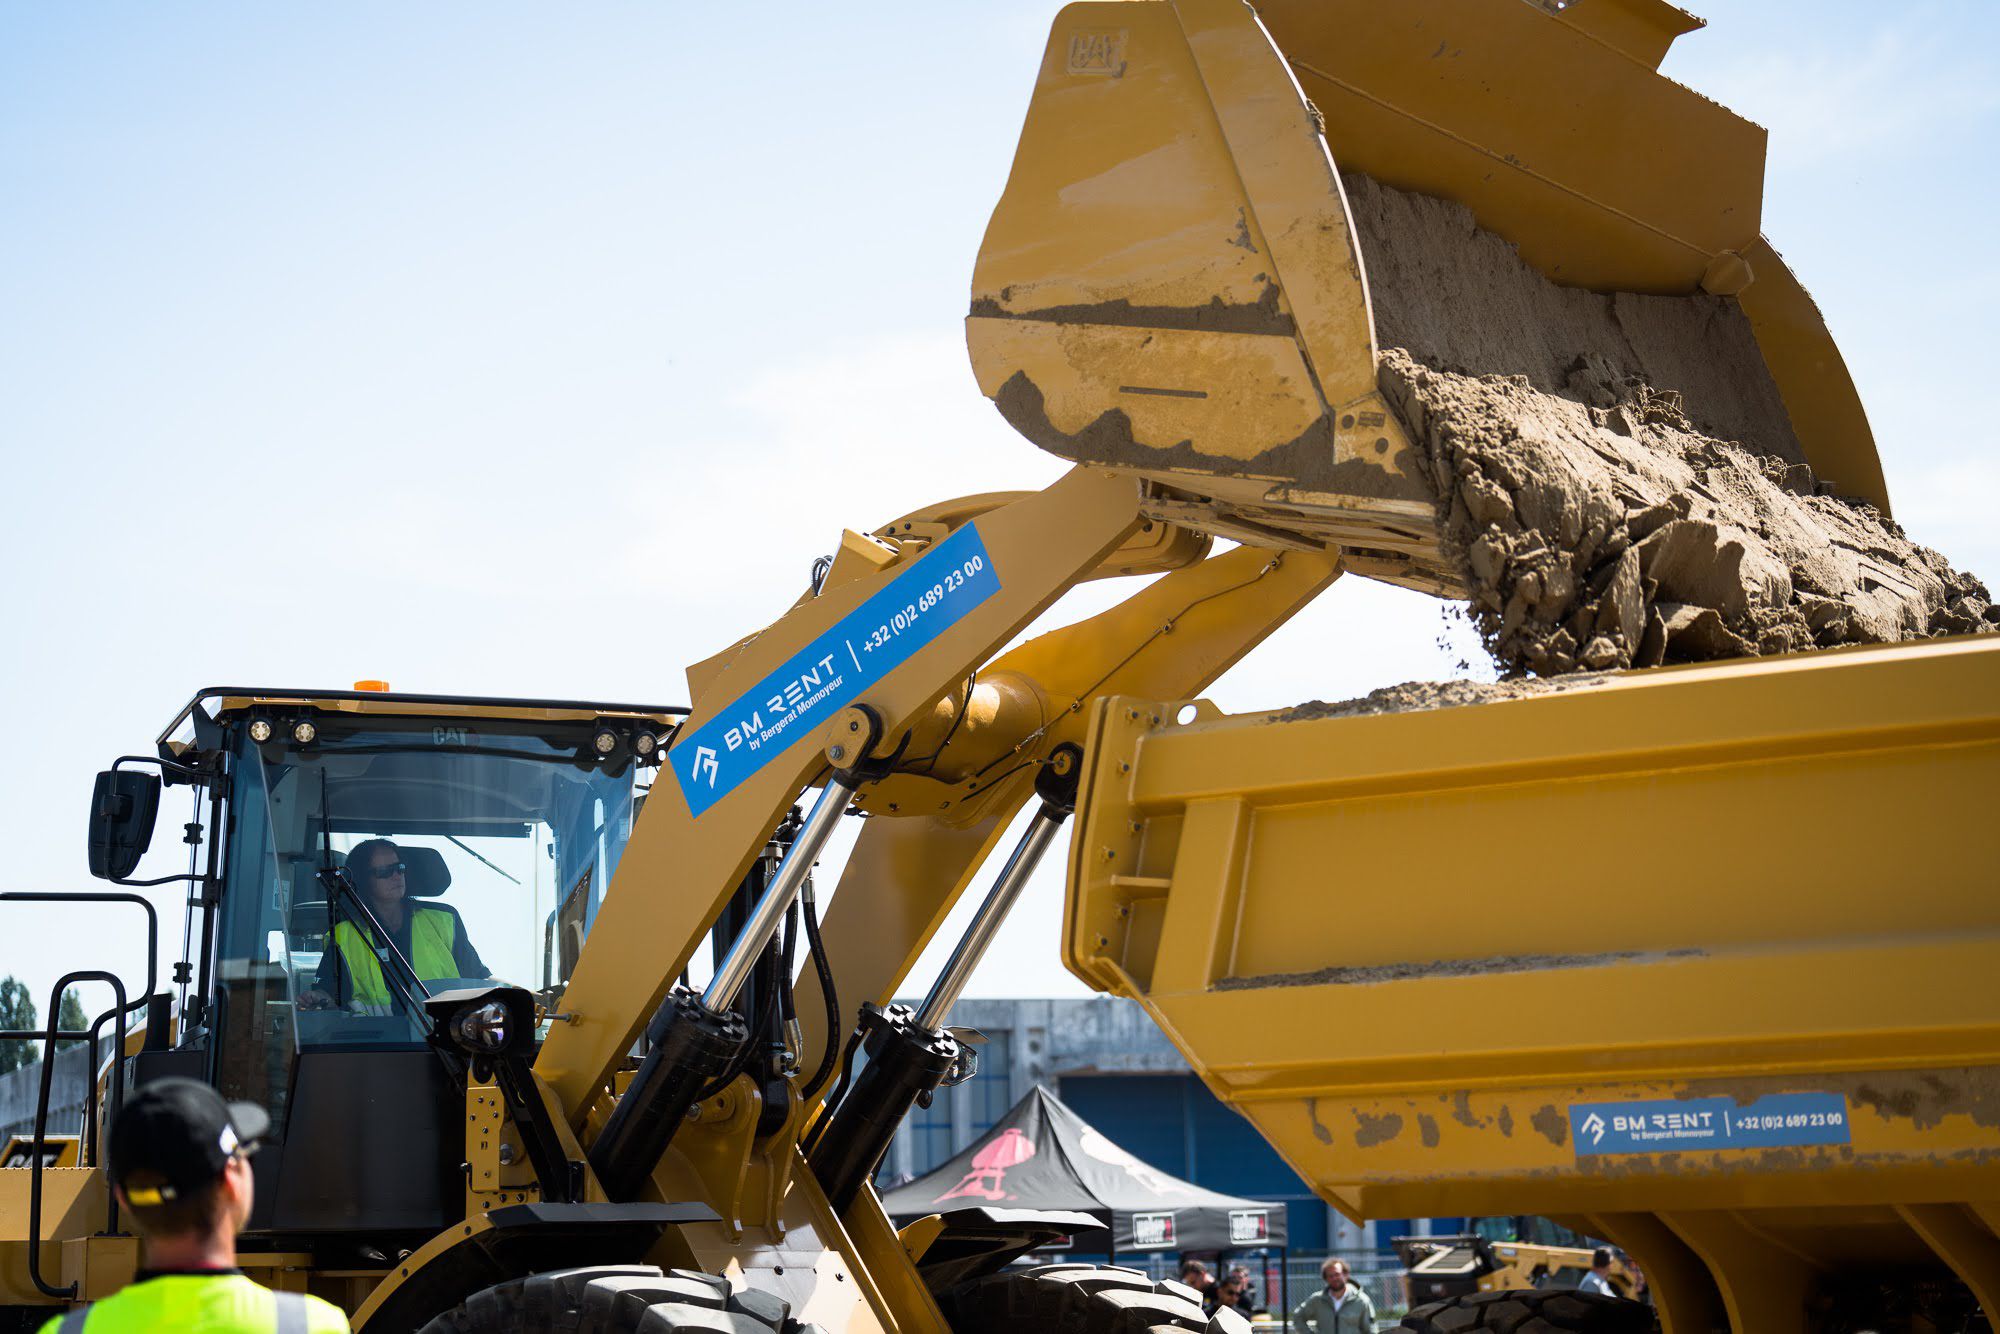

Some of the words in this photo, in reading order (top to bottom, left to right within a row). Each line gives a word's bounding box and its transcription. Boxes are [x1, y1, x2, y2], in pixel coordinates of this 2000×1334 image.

[863, 625, 891, 652] +32
[890, 604, 919, 636] (0)2
[918, 584, 943, 612] 689
[944, 570, 964, 593] 23
[963, 555, 983, 578] 00
[723, 711, 763, 752] BM
[766, 653, 834, 713] RENT
[749, 737, 761, 751] by
[760, 709, 798, 742] Bergerat
[796, 675, 844, 715] Monnoyeur
[432, 727, 467, 746] CAT
[1613, 1115, 1646, 1131] BM
[1652, 1112, 1713, 1129] RENT
[1736, 1116, 1759, 1129] +32
[1761, 1115, 1784, 1131] (0)2
[1786, 1114, 1808, 1128] 689
[1810, 1113, 1825, 1126] 23
[1827, 1112, 1843, 1126] 00
